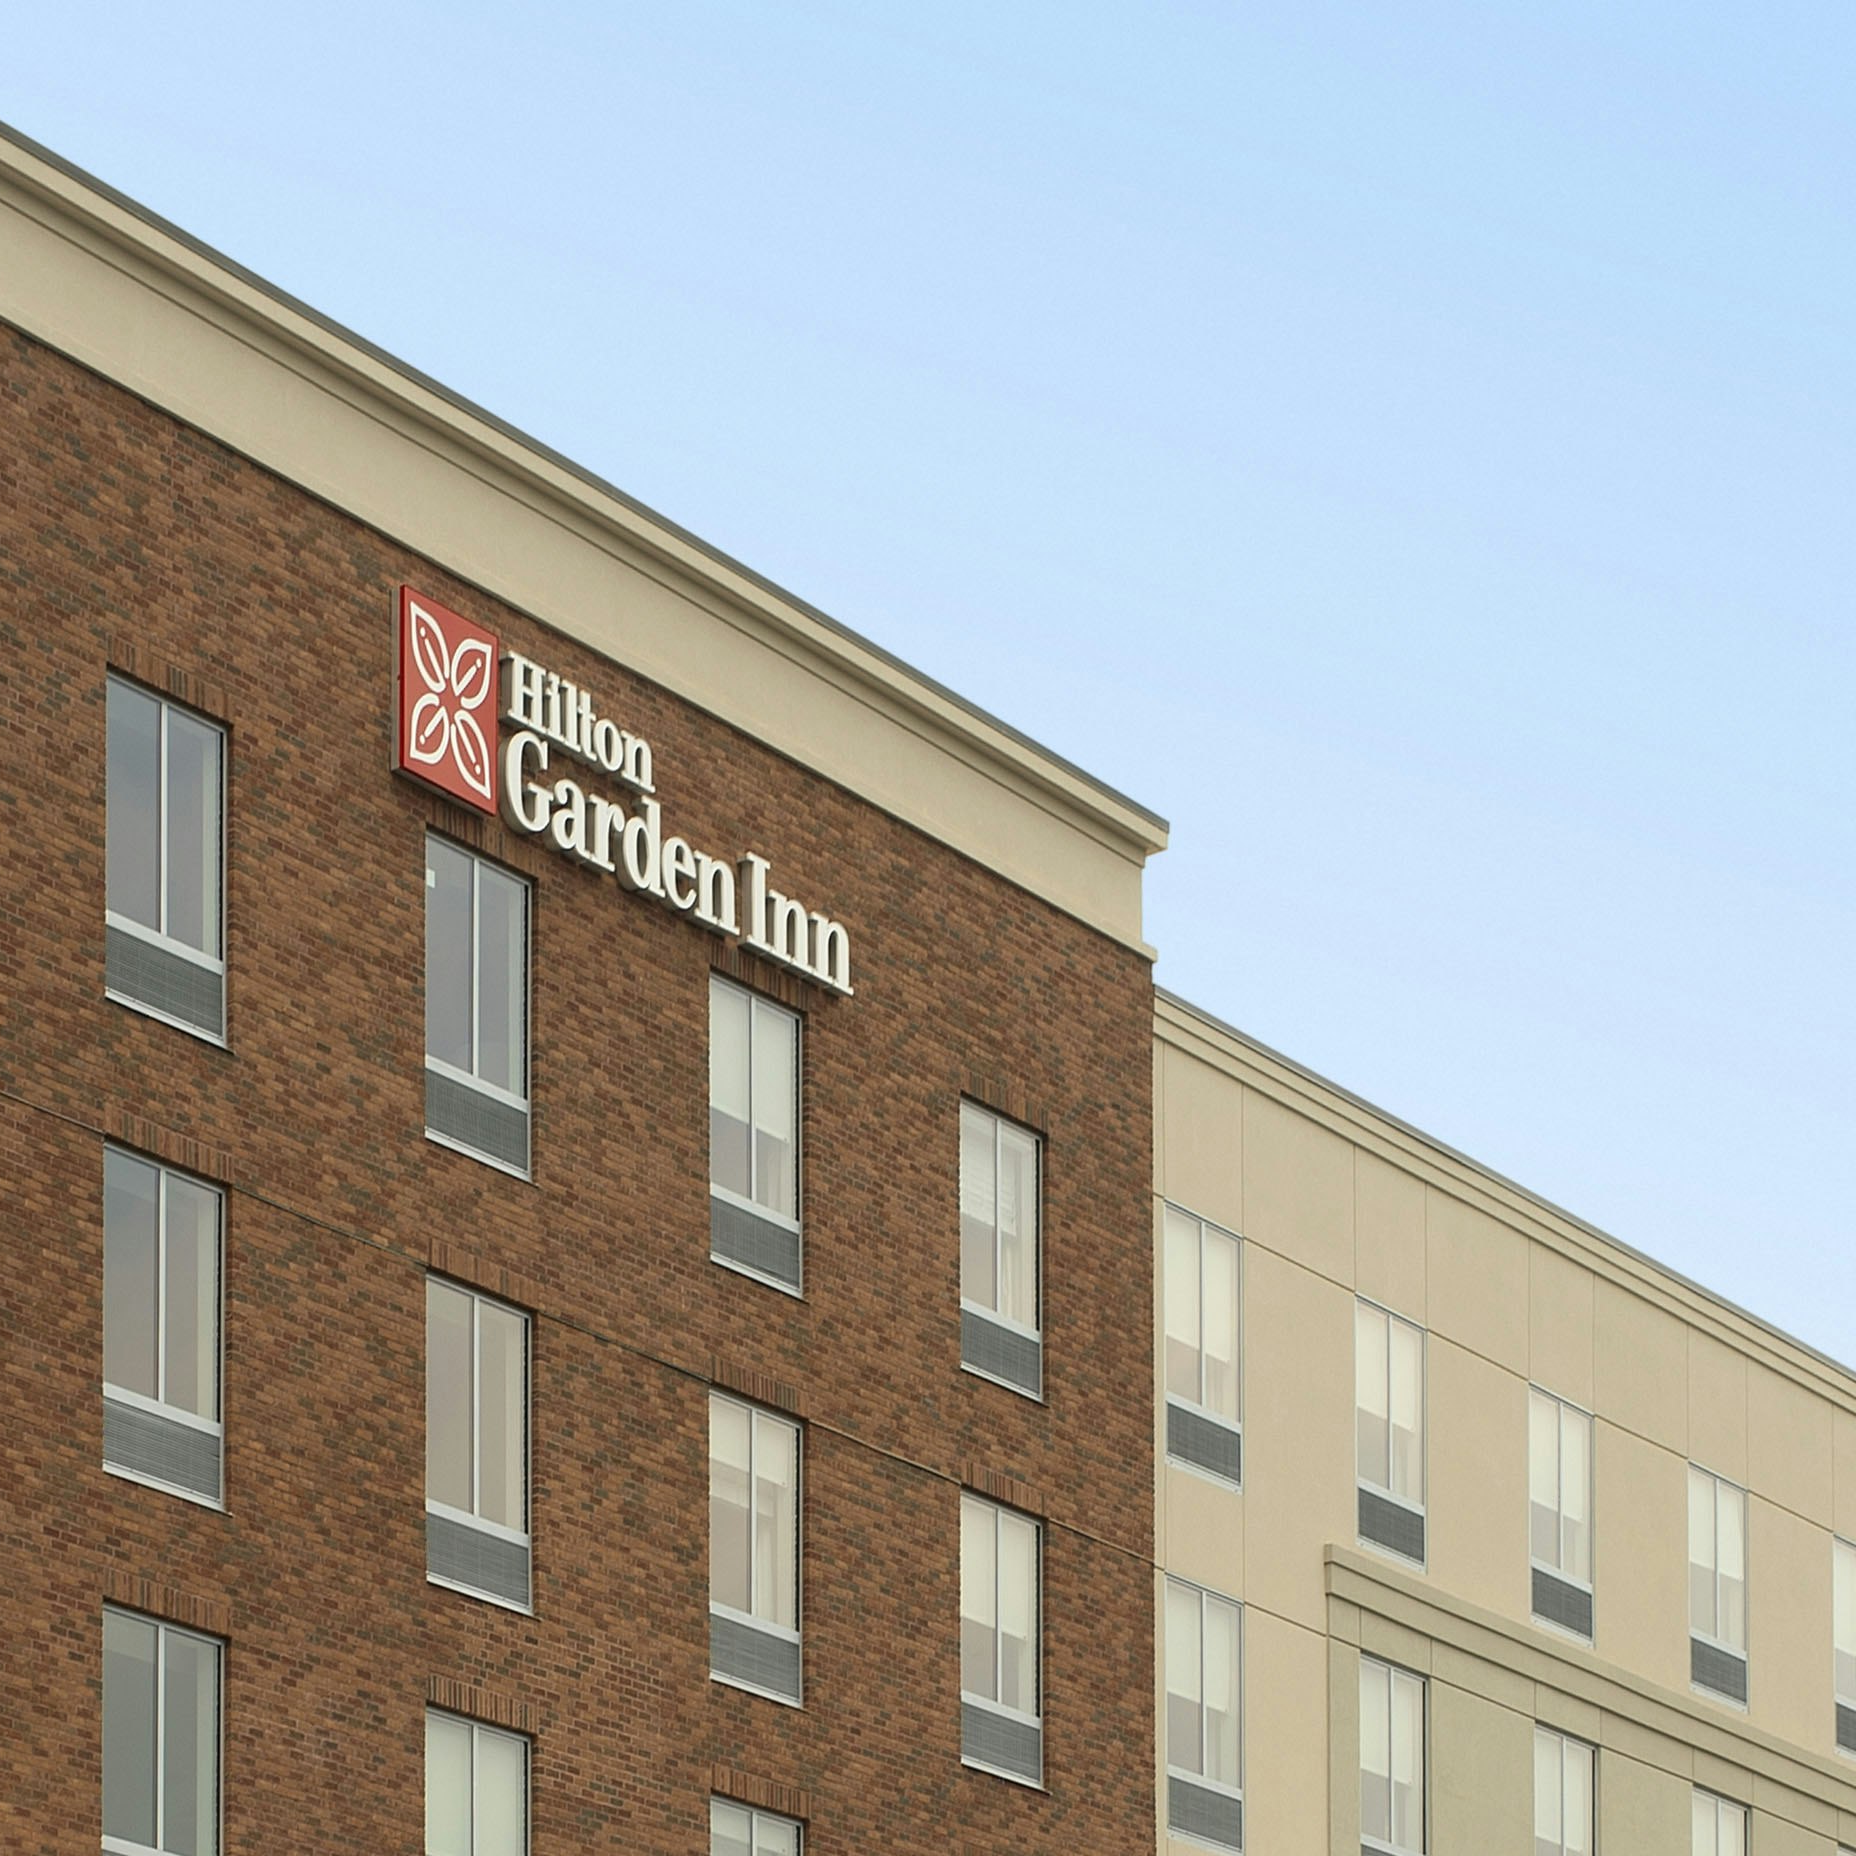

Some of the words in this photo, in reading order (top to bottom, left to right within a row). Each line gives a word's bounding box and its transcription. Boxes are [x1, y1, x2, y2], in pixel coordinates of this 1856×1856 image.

[502, 650, 656, 794] Hilton
[501, 729, 740, 937] Garden
[742, 851, 854, 996] Inn
